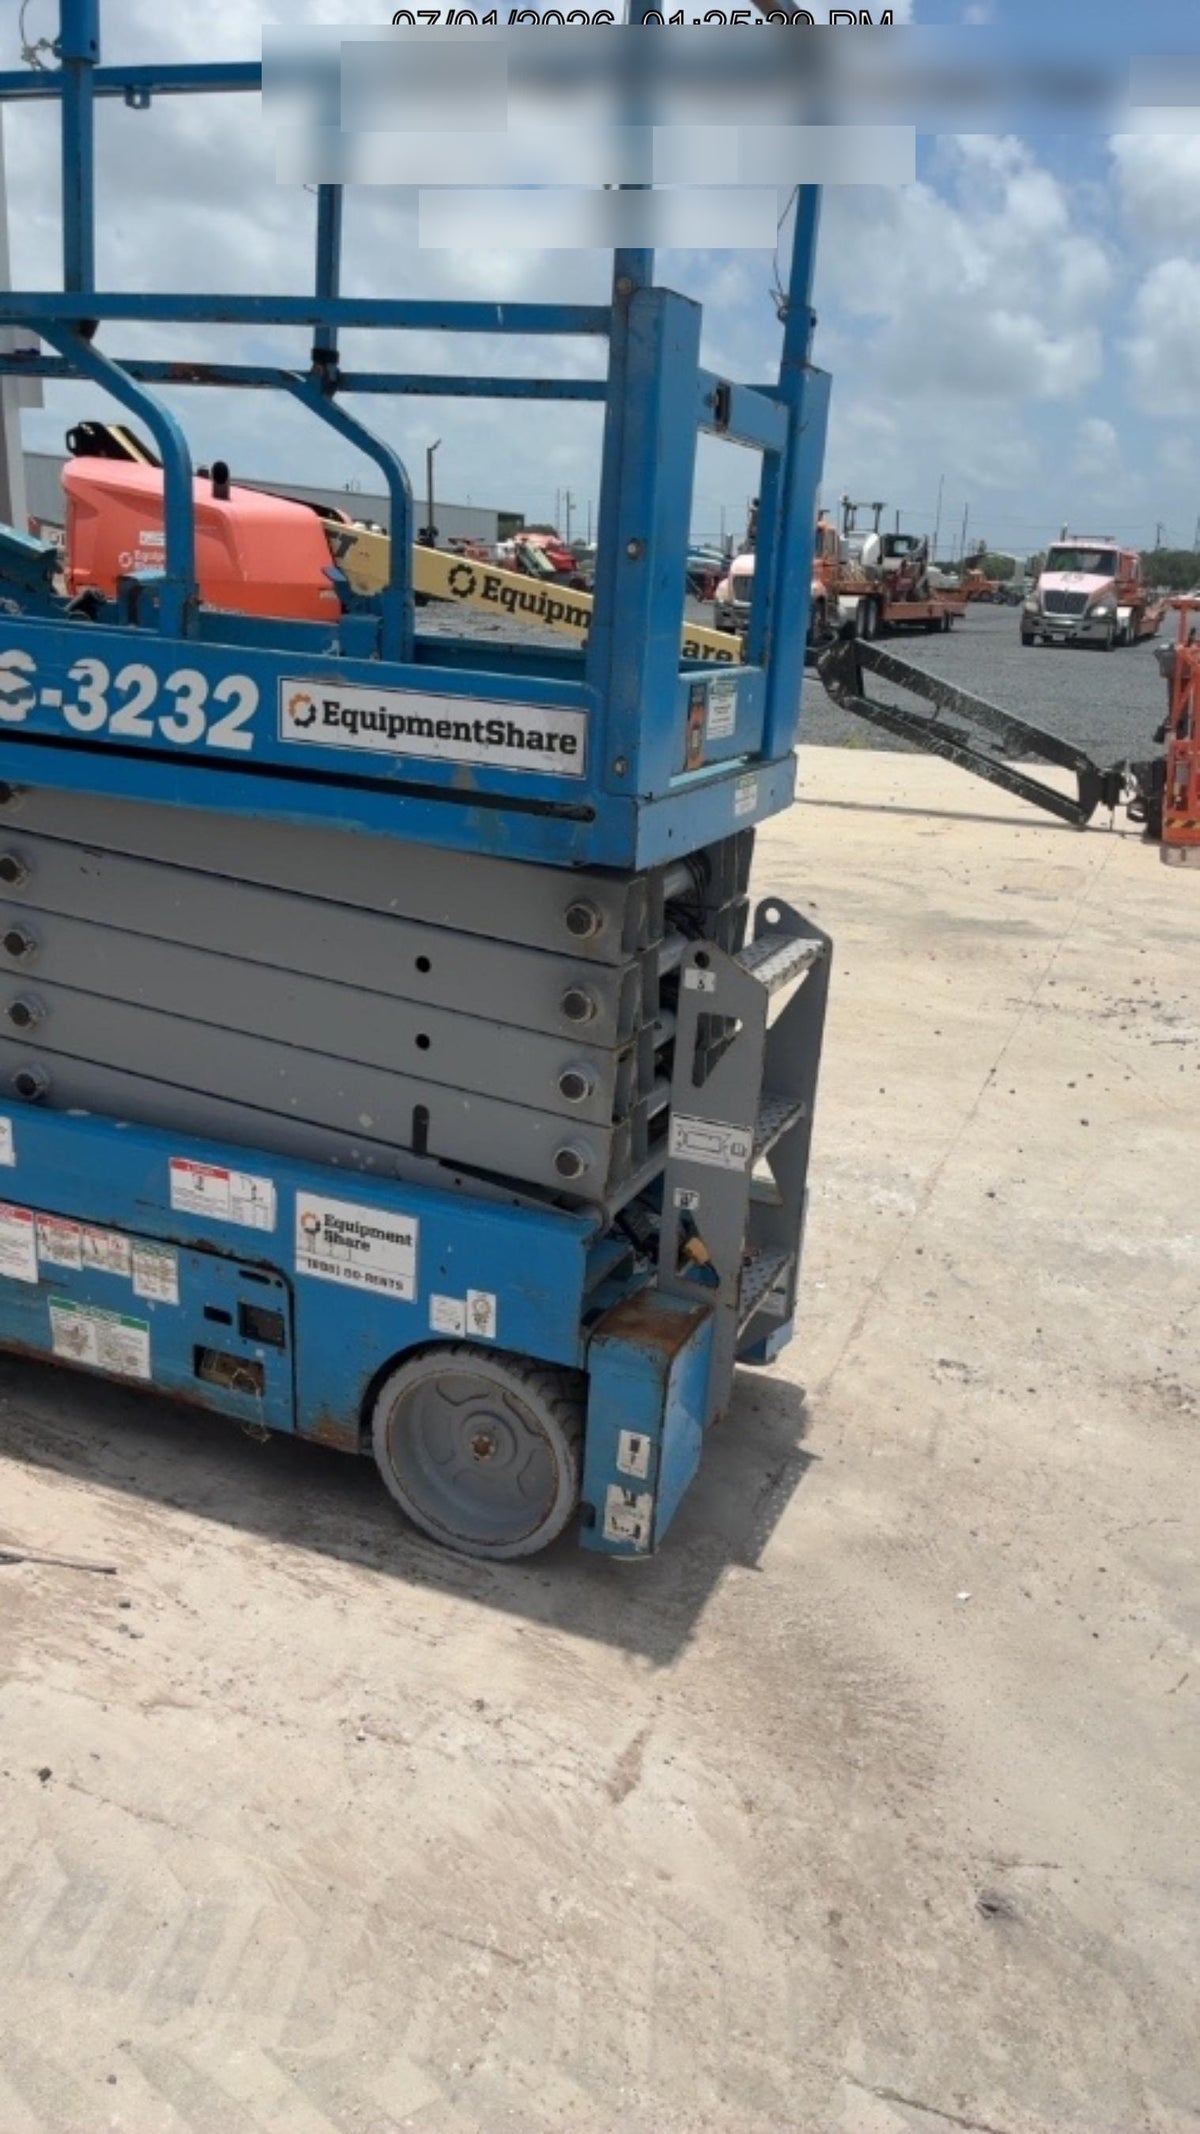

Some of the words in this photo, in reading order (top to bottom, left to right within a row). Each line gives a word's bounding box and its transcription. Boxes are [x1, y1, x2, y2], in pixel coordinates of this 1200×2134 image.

[322, 700, 578, 754] EquipmentShare
[324, 1213, 413, 1246] Equipment
[324, 1229, 371, 1252] Share
